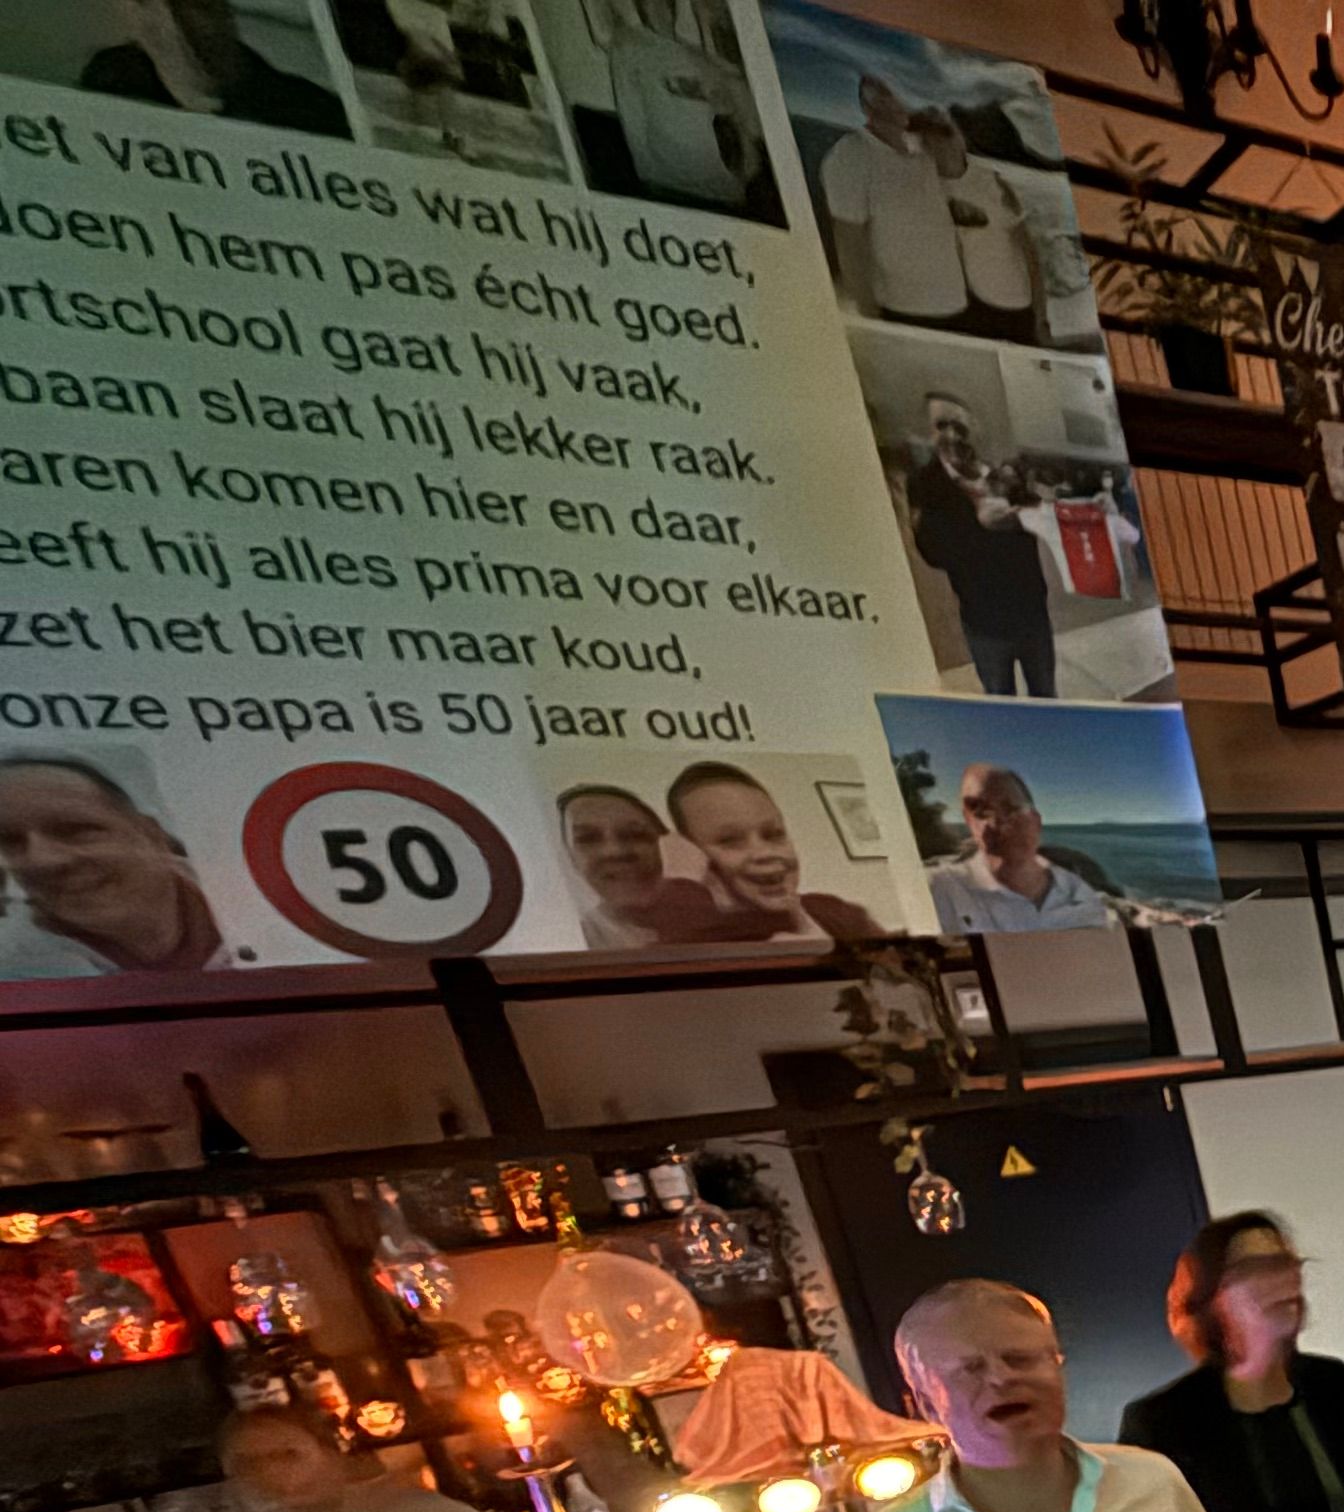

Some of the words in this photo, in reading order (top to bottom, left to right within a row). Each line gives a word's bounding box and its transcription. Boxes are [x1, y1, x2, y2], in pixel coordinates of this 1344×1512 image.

[0, 114, 81, 165] et
[93, 131, 228, 190] van
[245, 150, 399, 219] alles
[411, 187, 528, 243] wat
[536, 199, 611, 269] hij
[622, 219, 756, 289] doet,
[166, 210, 326, 283] hem
[339, 250, 458, 302] pas
[472, 262, 601, 328] écht
[612, 297, 761, 351] goed.
[0, 278, 303, 357] rtschool
[319, 324, 463, 378] gaat
[470, 331, 549, 400] hij
[556, 358, 702, 416] vaak,
[198, 378, 365, 441] slaat
[371, 393, 455, 461] hij
[461, 404, 631, 470] lekker
[648, 437, 776, 486] raak.
[170, 448, 406, 517] komen
[414, 472, 529, 527] hier
[547, 497, 617, 537] en
[629, 496, 757, 555] daar,
[139, 524, 232, 591] hij
[247, 535, 400, 590] alles
[412, 550, 584, 603] prima
[593, 571, 709, 610] voor
[725, 572, 880, 625] elkaar.
[0, 606, 103, 652] zet
[110, 601, 234, 656] het
[240, 607, 366, 661] bier
[386, 627, 538, 667] maar
[550, 624, 703, 682] koud,
[0, 692, 171, 732] onze
[186, 695, 355, 744] papa
[364, 689, 425, 735] is
[437, 691, 514, 736] 50
[524, 693, 628, 748] jaar
[644, 700, 756, 743] oud!
[320, 825, 459, 905] 50
